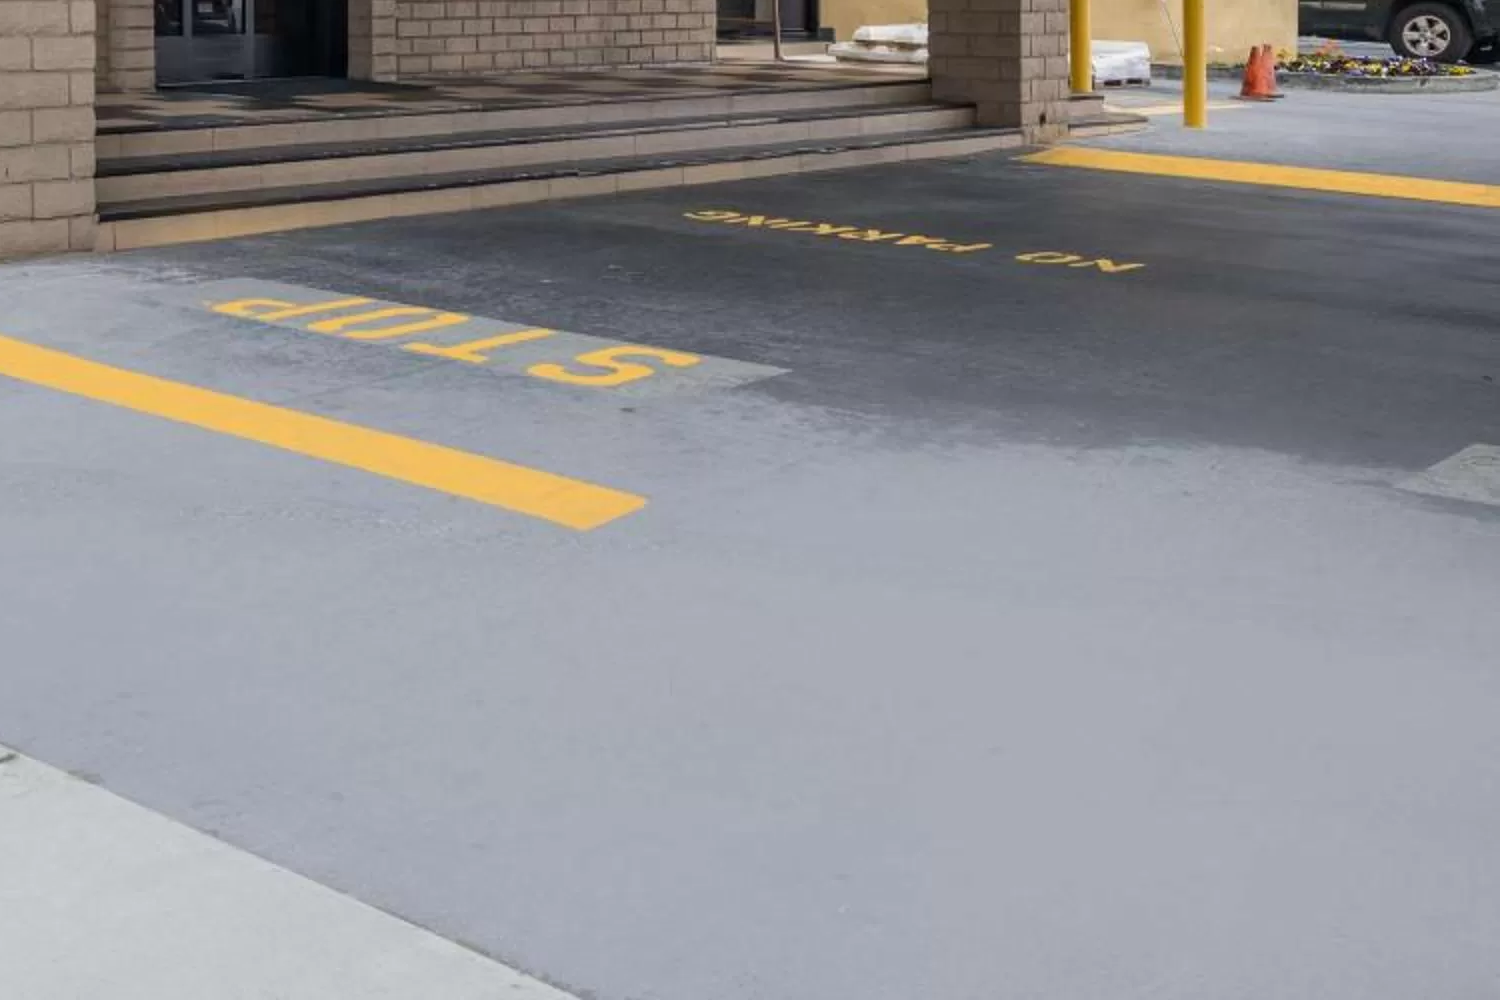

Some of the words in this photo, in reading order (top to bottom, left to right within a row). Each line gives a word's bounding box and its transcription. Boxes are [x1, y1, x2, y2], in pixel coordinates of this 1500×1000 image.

[683, 209, 993, 254] PARKING
[1014, 250, 1145, 274] NO
[209, 296, 702, 387] STOP
